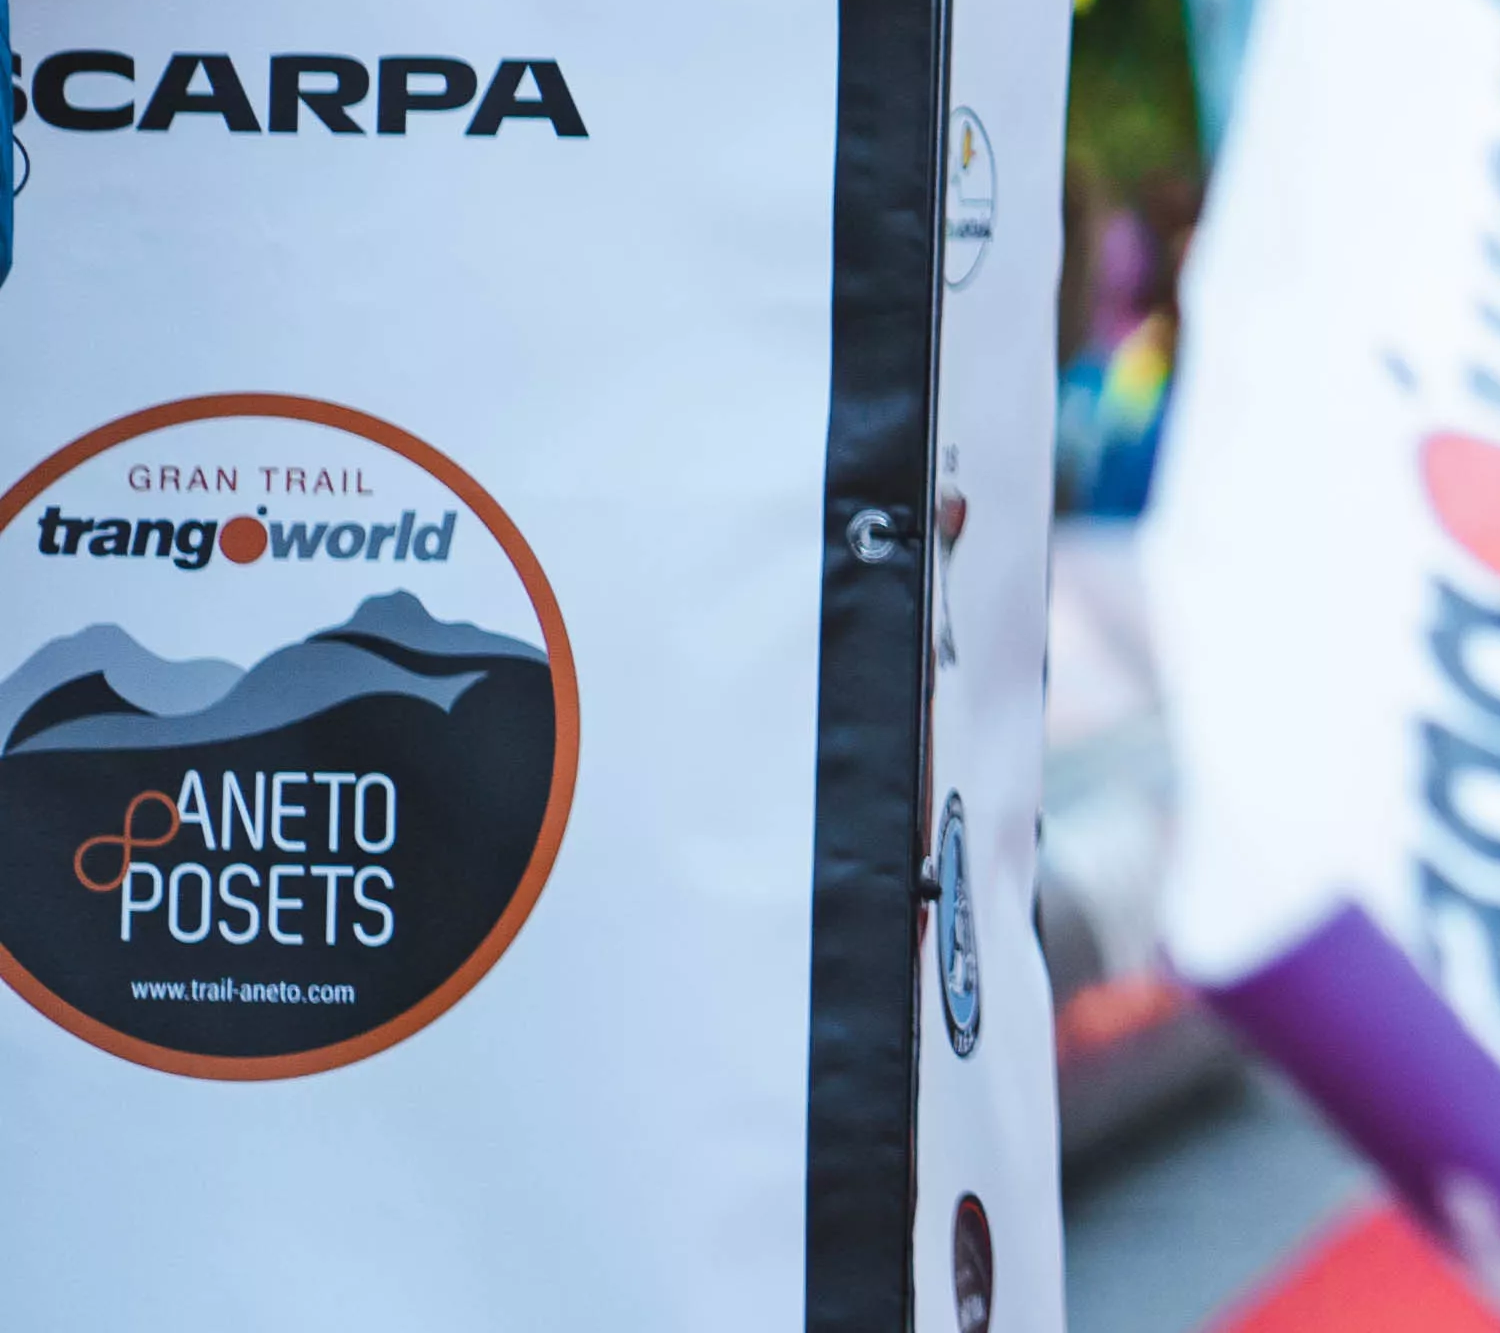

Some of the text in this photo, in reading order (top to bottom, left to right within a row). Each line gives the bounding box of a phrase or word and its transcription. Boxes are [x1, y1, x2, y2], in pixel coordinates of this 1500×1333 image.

[129, 465, 373, 496] GRAN TRAIL
[177, 768, 397, 854] ANETO
[121, 862, 395, 948] POSETS
[131, 977, 356, 1005] www.trail-aneto.com
